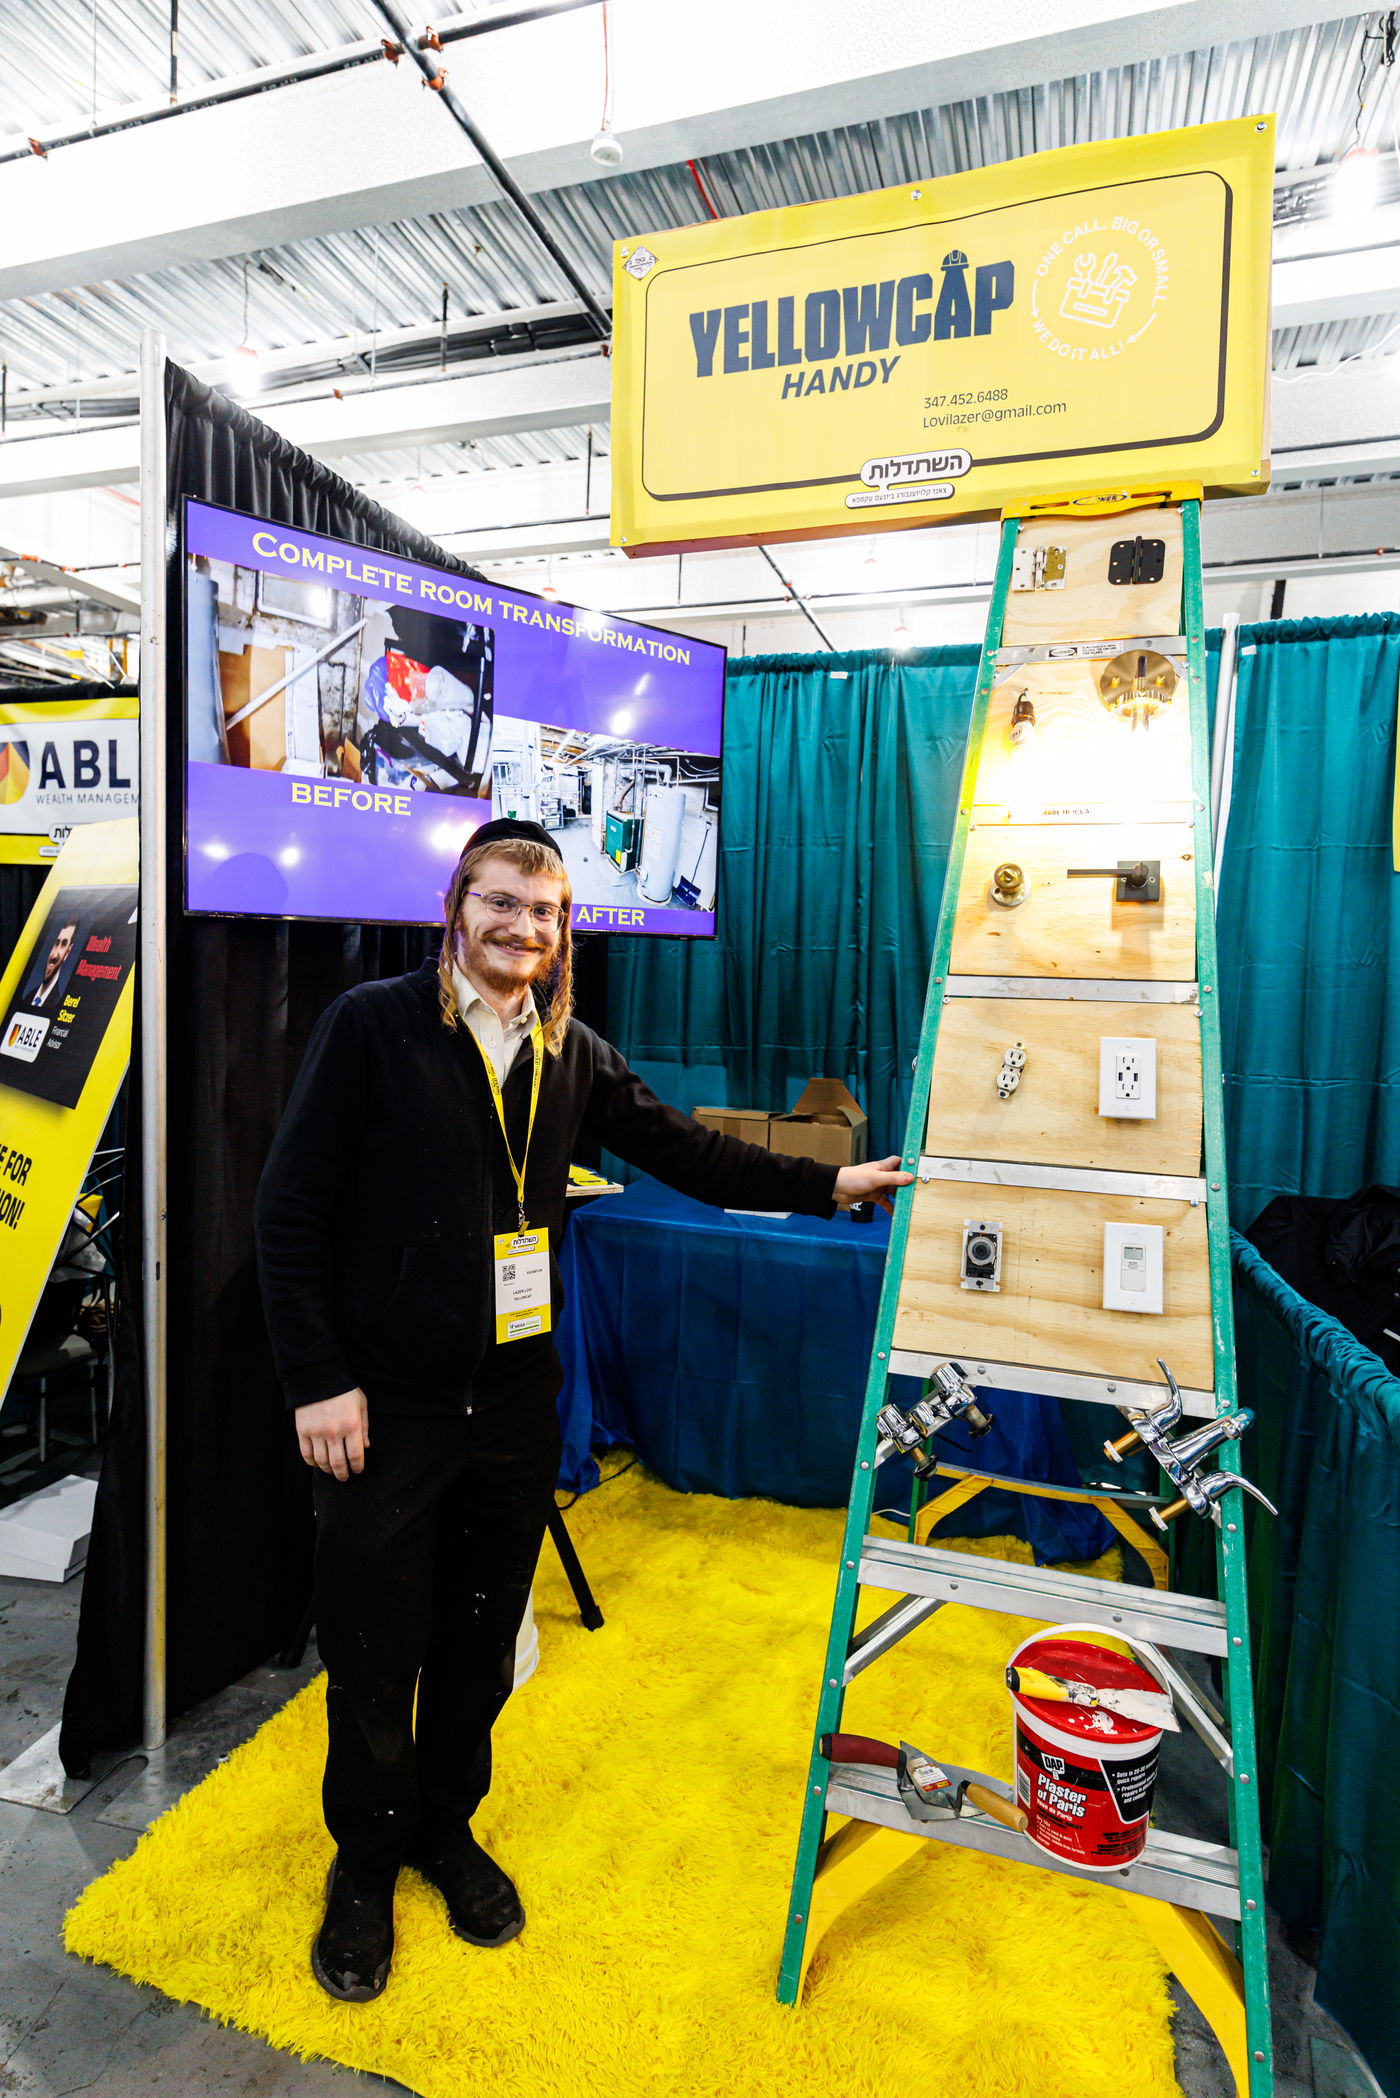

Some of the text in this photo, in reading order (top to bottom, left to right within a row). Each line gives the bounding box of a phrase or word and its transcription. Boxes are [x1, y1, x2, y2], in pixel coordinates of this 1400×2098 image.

[1036, 241, 1064, 276] ONE
[1111, 216, 1139, 234] BIG
[1138, 229, 1159, 251] OR
[689, 250, 1015, 378] YELLOWCAP
[1032, 318, 1126, 361] WE DO IT ALL!
[781, 355, 901, 400] HANDY
[923, 388, 1009, 409] 347.452.6488
[923, 402, 1067, 428] Lovilazer@gmail.com
[868, 455, 963, 480] השתדלות
[252, 532, 691, 666] COMPLETE ROOM TRANSFORMATION
[36, 793, 73, 805] WEALTH
[291, 782, 412, 817] BEFORE
[576, 906, 645, 926] AFTER
[86, 935, 112, 953] Wealth
[75, 959, 122, 981] Management
[64, 994, 81, 1008] Berel
[17, 1026, 42, 1048] ABLE
[3, 1150, 32, 1187] FOR
[1038, 1772, 1087, 1804] Plaster
[1037, 1789, 1048, 1801] of
[1048, 1792, 1086, 1818] Paris
